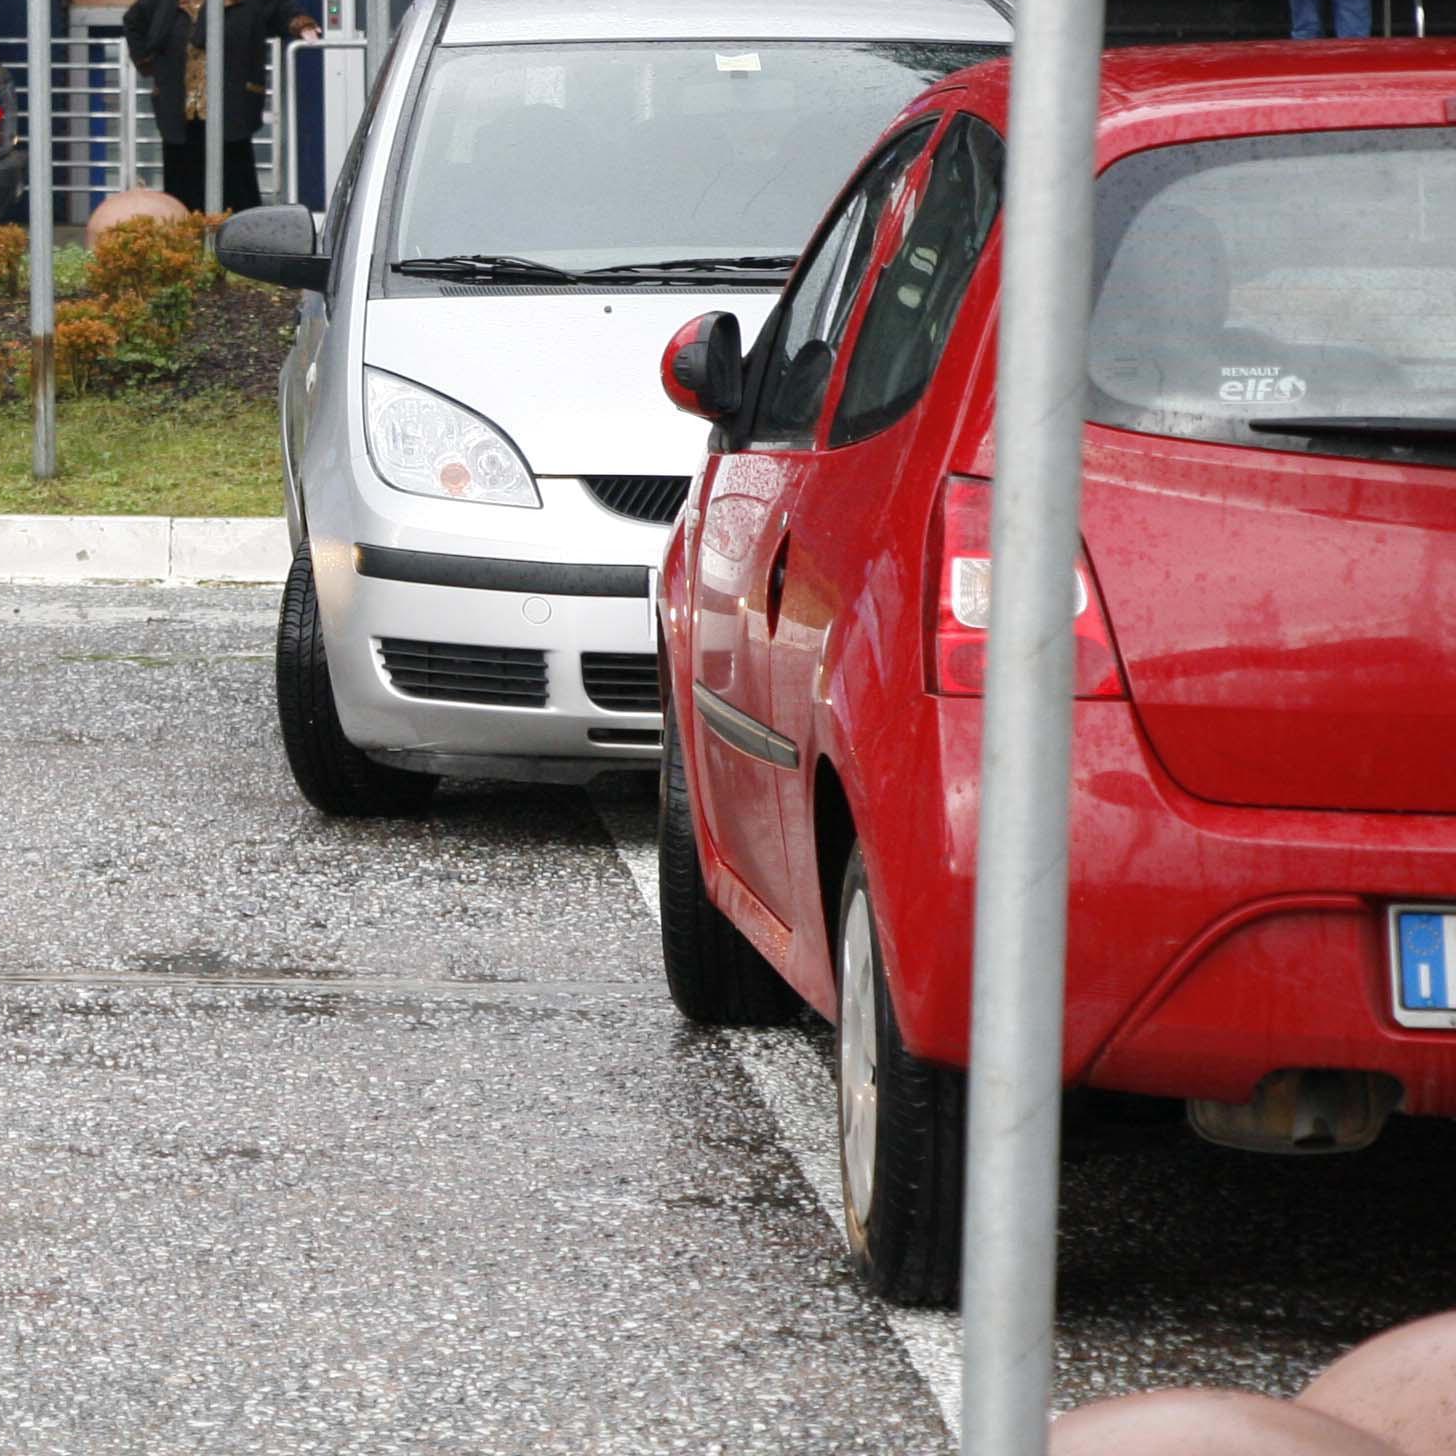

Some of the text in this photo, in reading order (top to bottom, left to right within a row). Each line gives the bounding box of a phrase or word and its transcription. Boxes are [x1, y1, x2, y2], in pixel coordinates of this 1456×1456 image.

[1221, 366, 1281, 377] RENAULT
[1219, 376, 1275, 401] elf
[1418, 963, 1432, 1000] I
